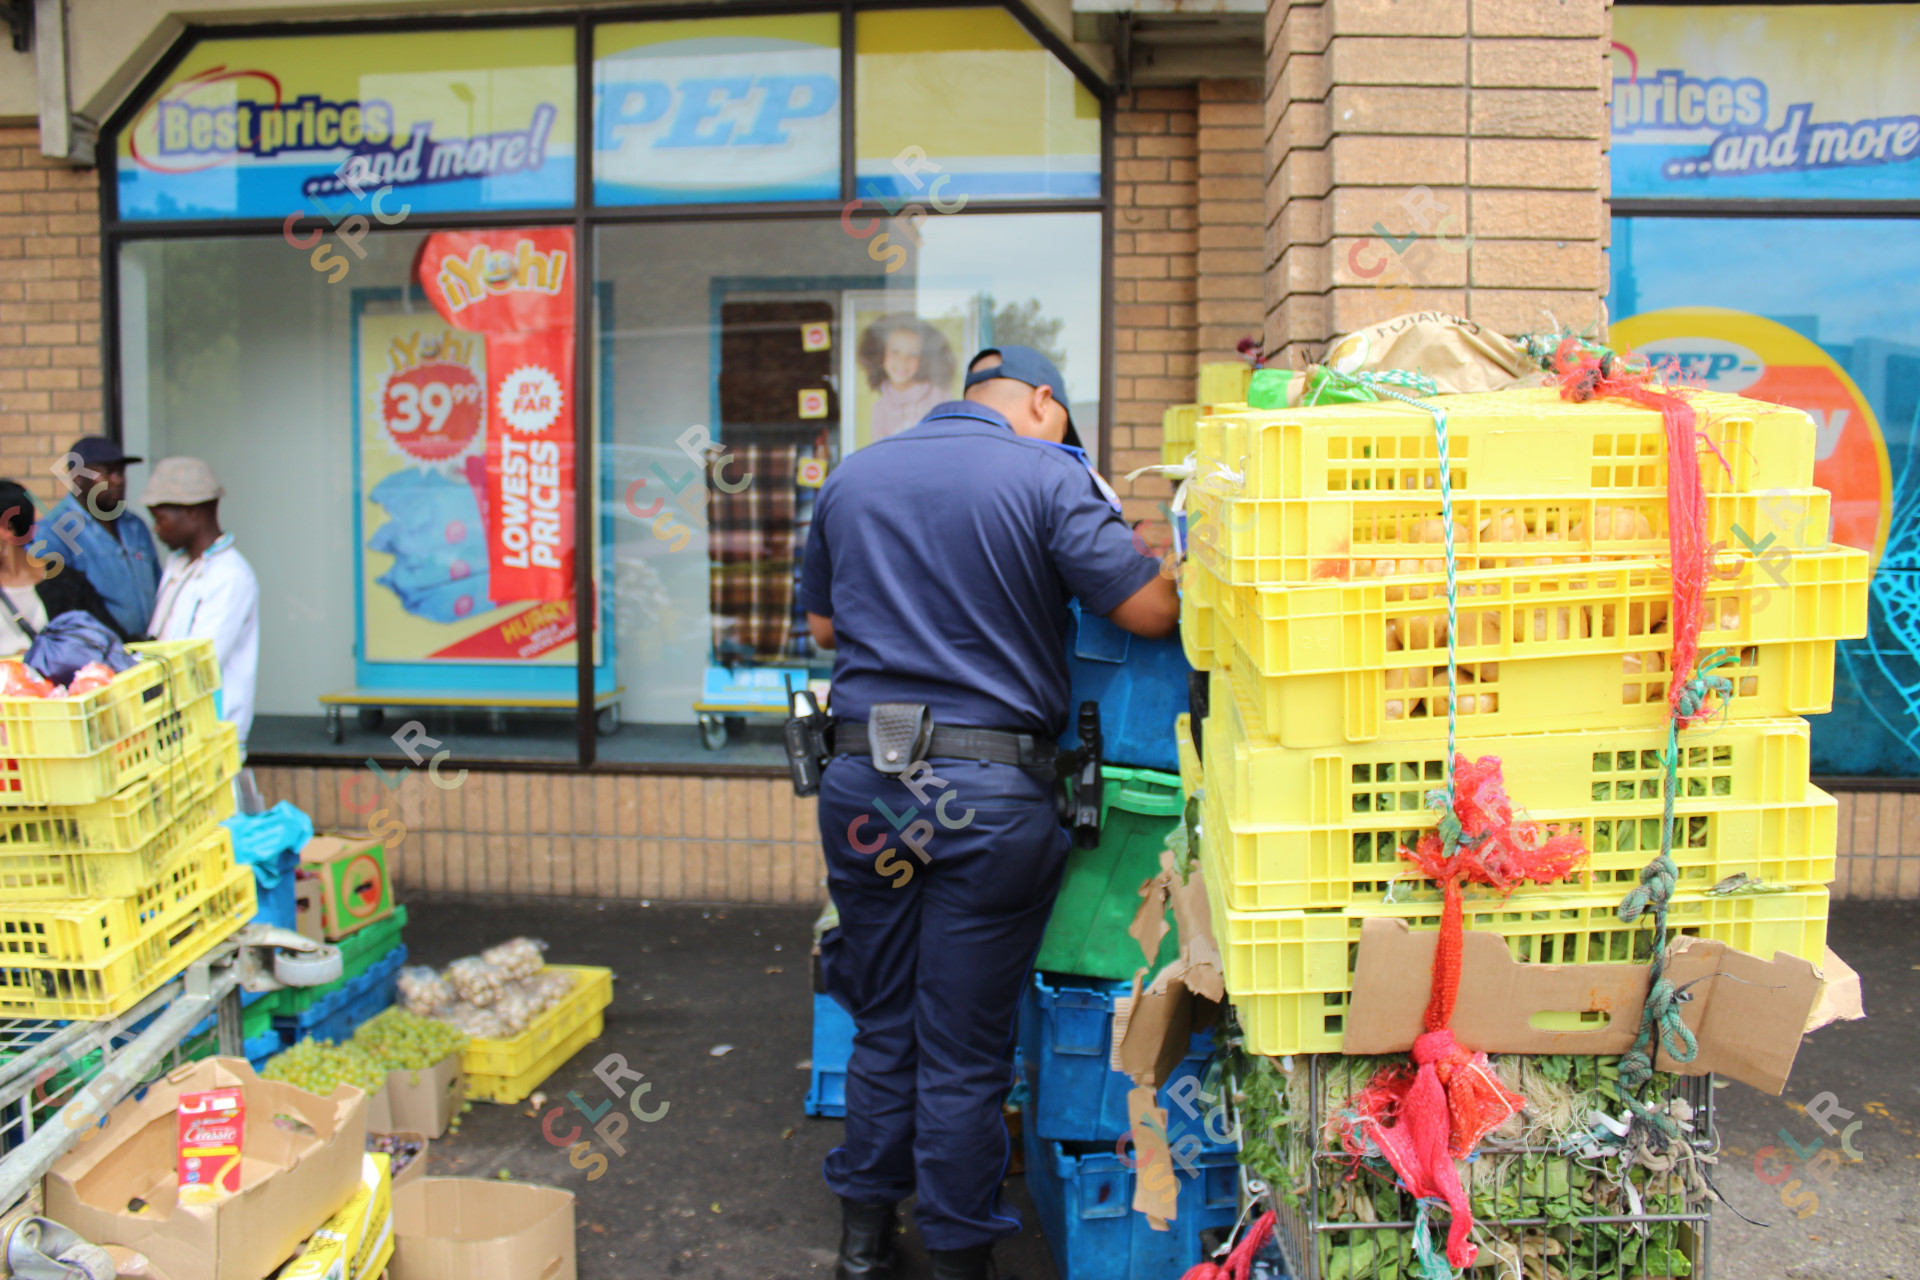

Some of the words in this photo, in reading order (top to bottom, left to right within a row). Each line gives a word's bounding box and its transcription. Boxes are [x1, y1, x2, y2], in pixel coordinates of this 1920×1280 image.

[163, 102, 254, 152] Best
[260, 101, 389, 150] prices
[593, 73, 838, 151] PEP
[1613, 76, 1762, 128] prices
[427, 106, 556, 178] more!
[388, 381, 453, 434] 39
[512, 396, 552, 414] FAR
[519, 381, 543, 396] BY
[502, 433, 529, 568] LOWEST
[530, 440, 561, 569] PRICES
